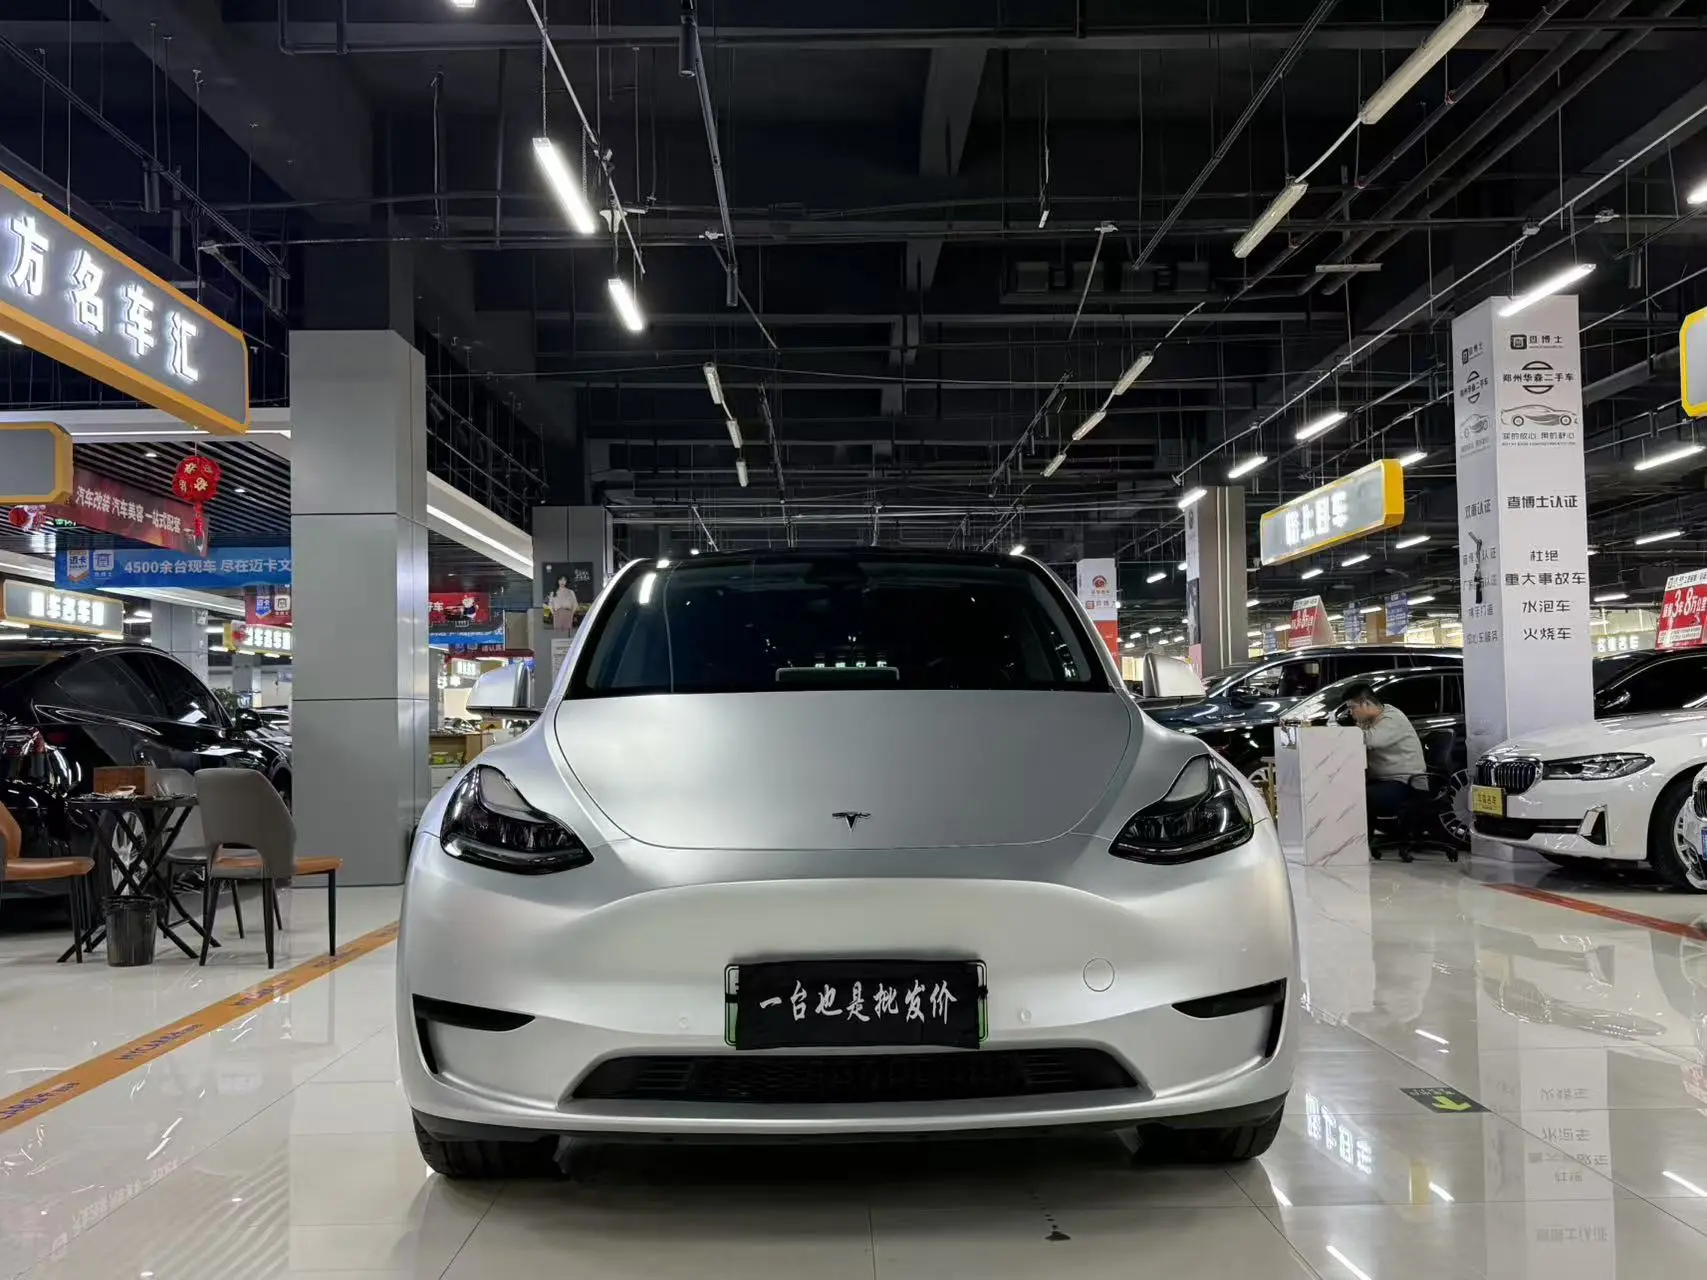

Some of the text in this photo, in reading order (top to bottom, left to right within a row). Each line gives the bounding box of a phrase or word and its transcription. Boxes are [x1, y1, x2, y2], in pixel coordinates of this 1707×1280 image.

[7, 215, 200, 384] 方名车汇
[1507, 495, 1578, 509] 查博士认证
[1530, 549, 1560, 562] 杜绝
[124, 559, 217, 574] 4500余台现车
[1505, 572, 1587, 586] 重大事故车
[1522, 599, 1572, 613] 水泡车
[1523, 627, 1573, 641] 火烧车
[760, 980, 958, 1024] 一台也是批发价
